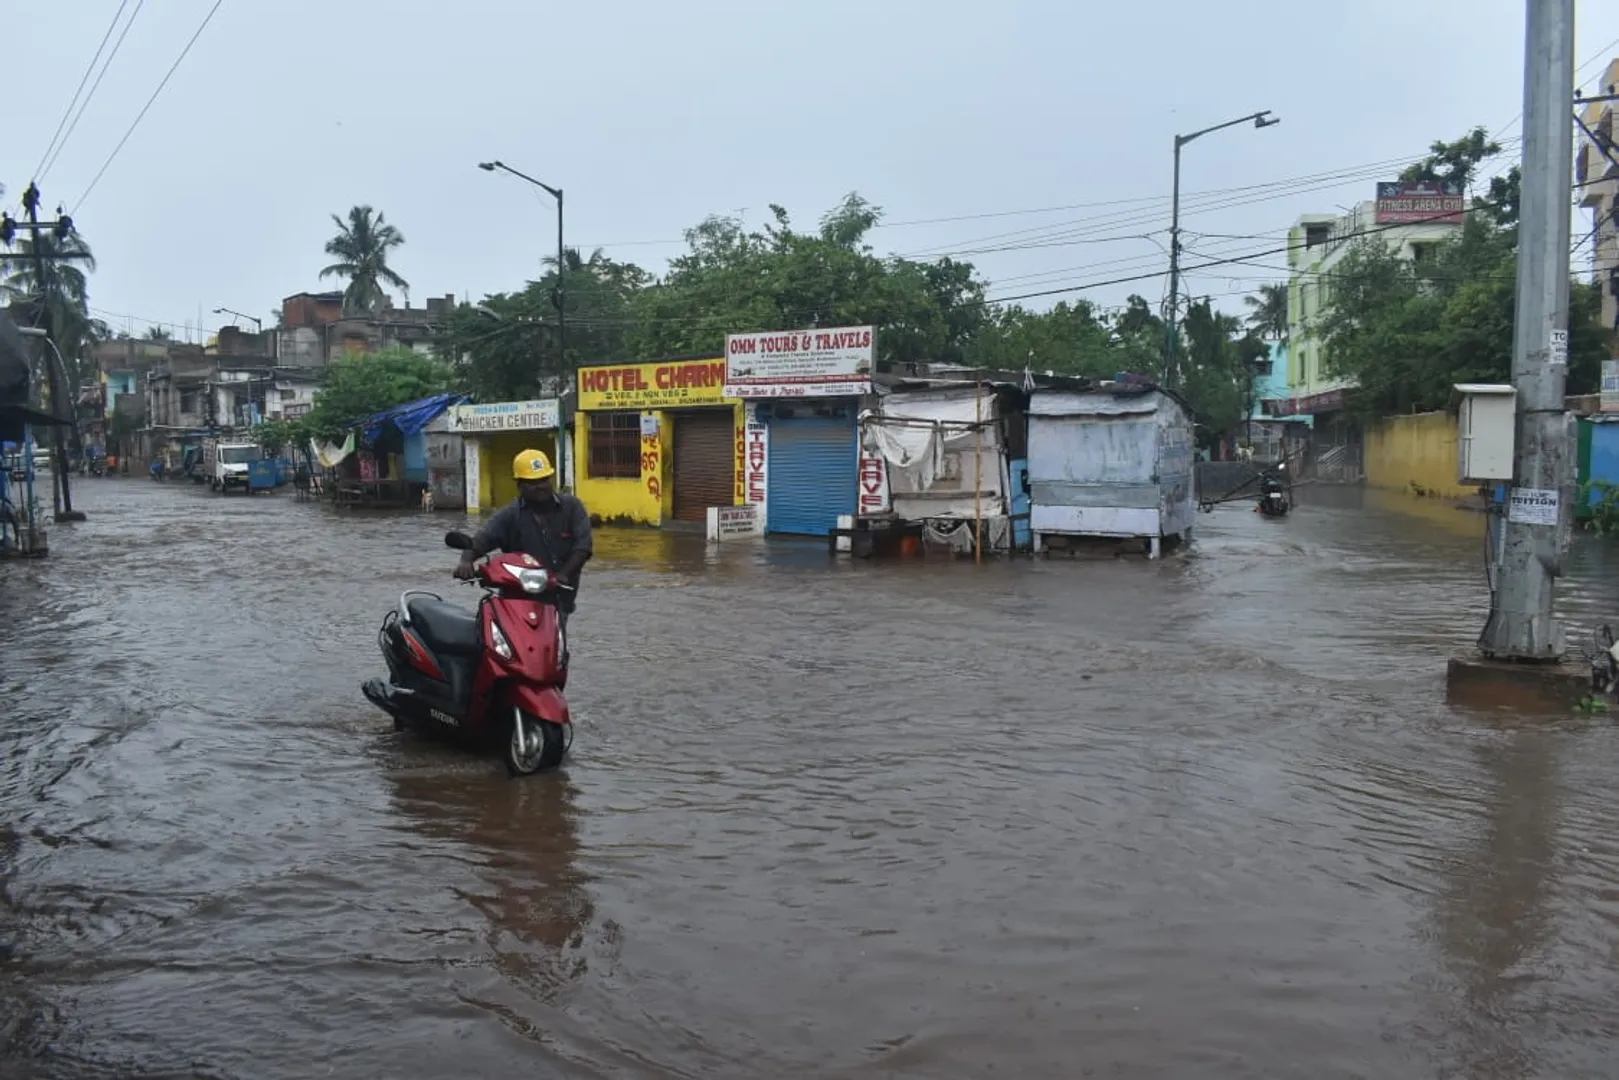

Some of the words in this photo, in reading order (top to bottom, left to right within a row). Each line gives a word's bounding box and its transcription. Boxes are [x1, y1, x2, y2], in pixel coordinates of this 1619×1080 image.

[1414, 198, 1442, 212] ARENA
[1443, 198, 1461, 212] GYM
[731, 338, 756, 354] OMM
[760, 335, 798, 353] TOURS
[802, 334, 811, 351] &
[815, 331, 870, 350] TRAVELS
[581, 367, 649, 393] HOTEL
[655, 362, 726, 389] CHARM
[507, 411, 547, 428] CENTRE
[736, 426, 745, 498] HOTEL
[749, 431, 766, 502] TRAVELS
